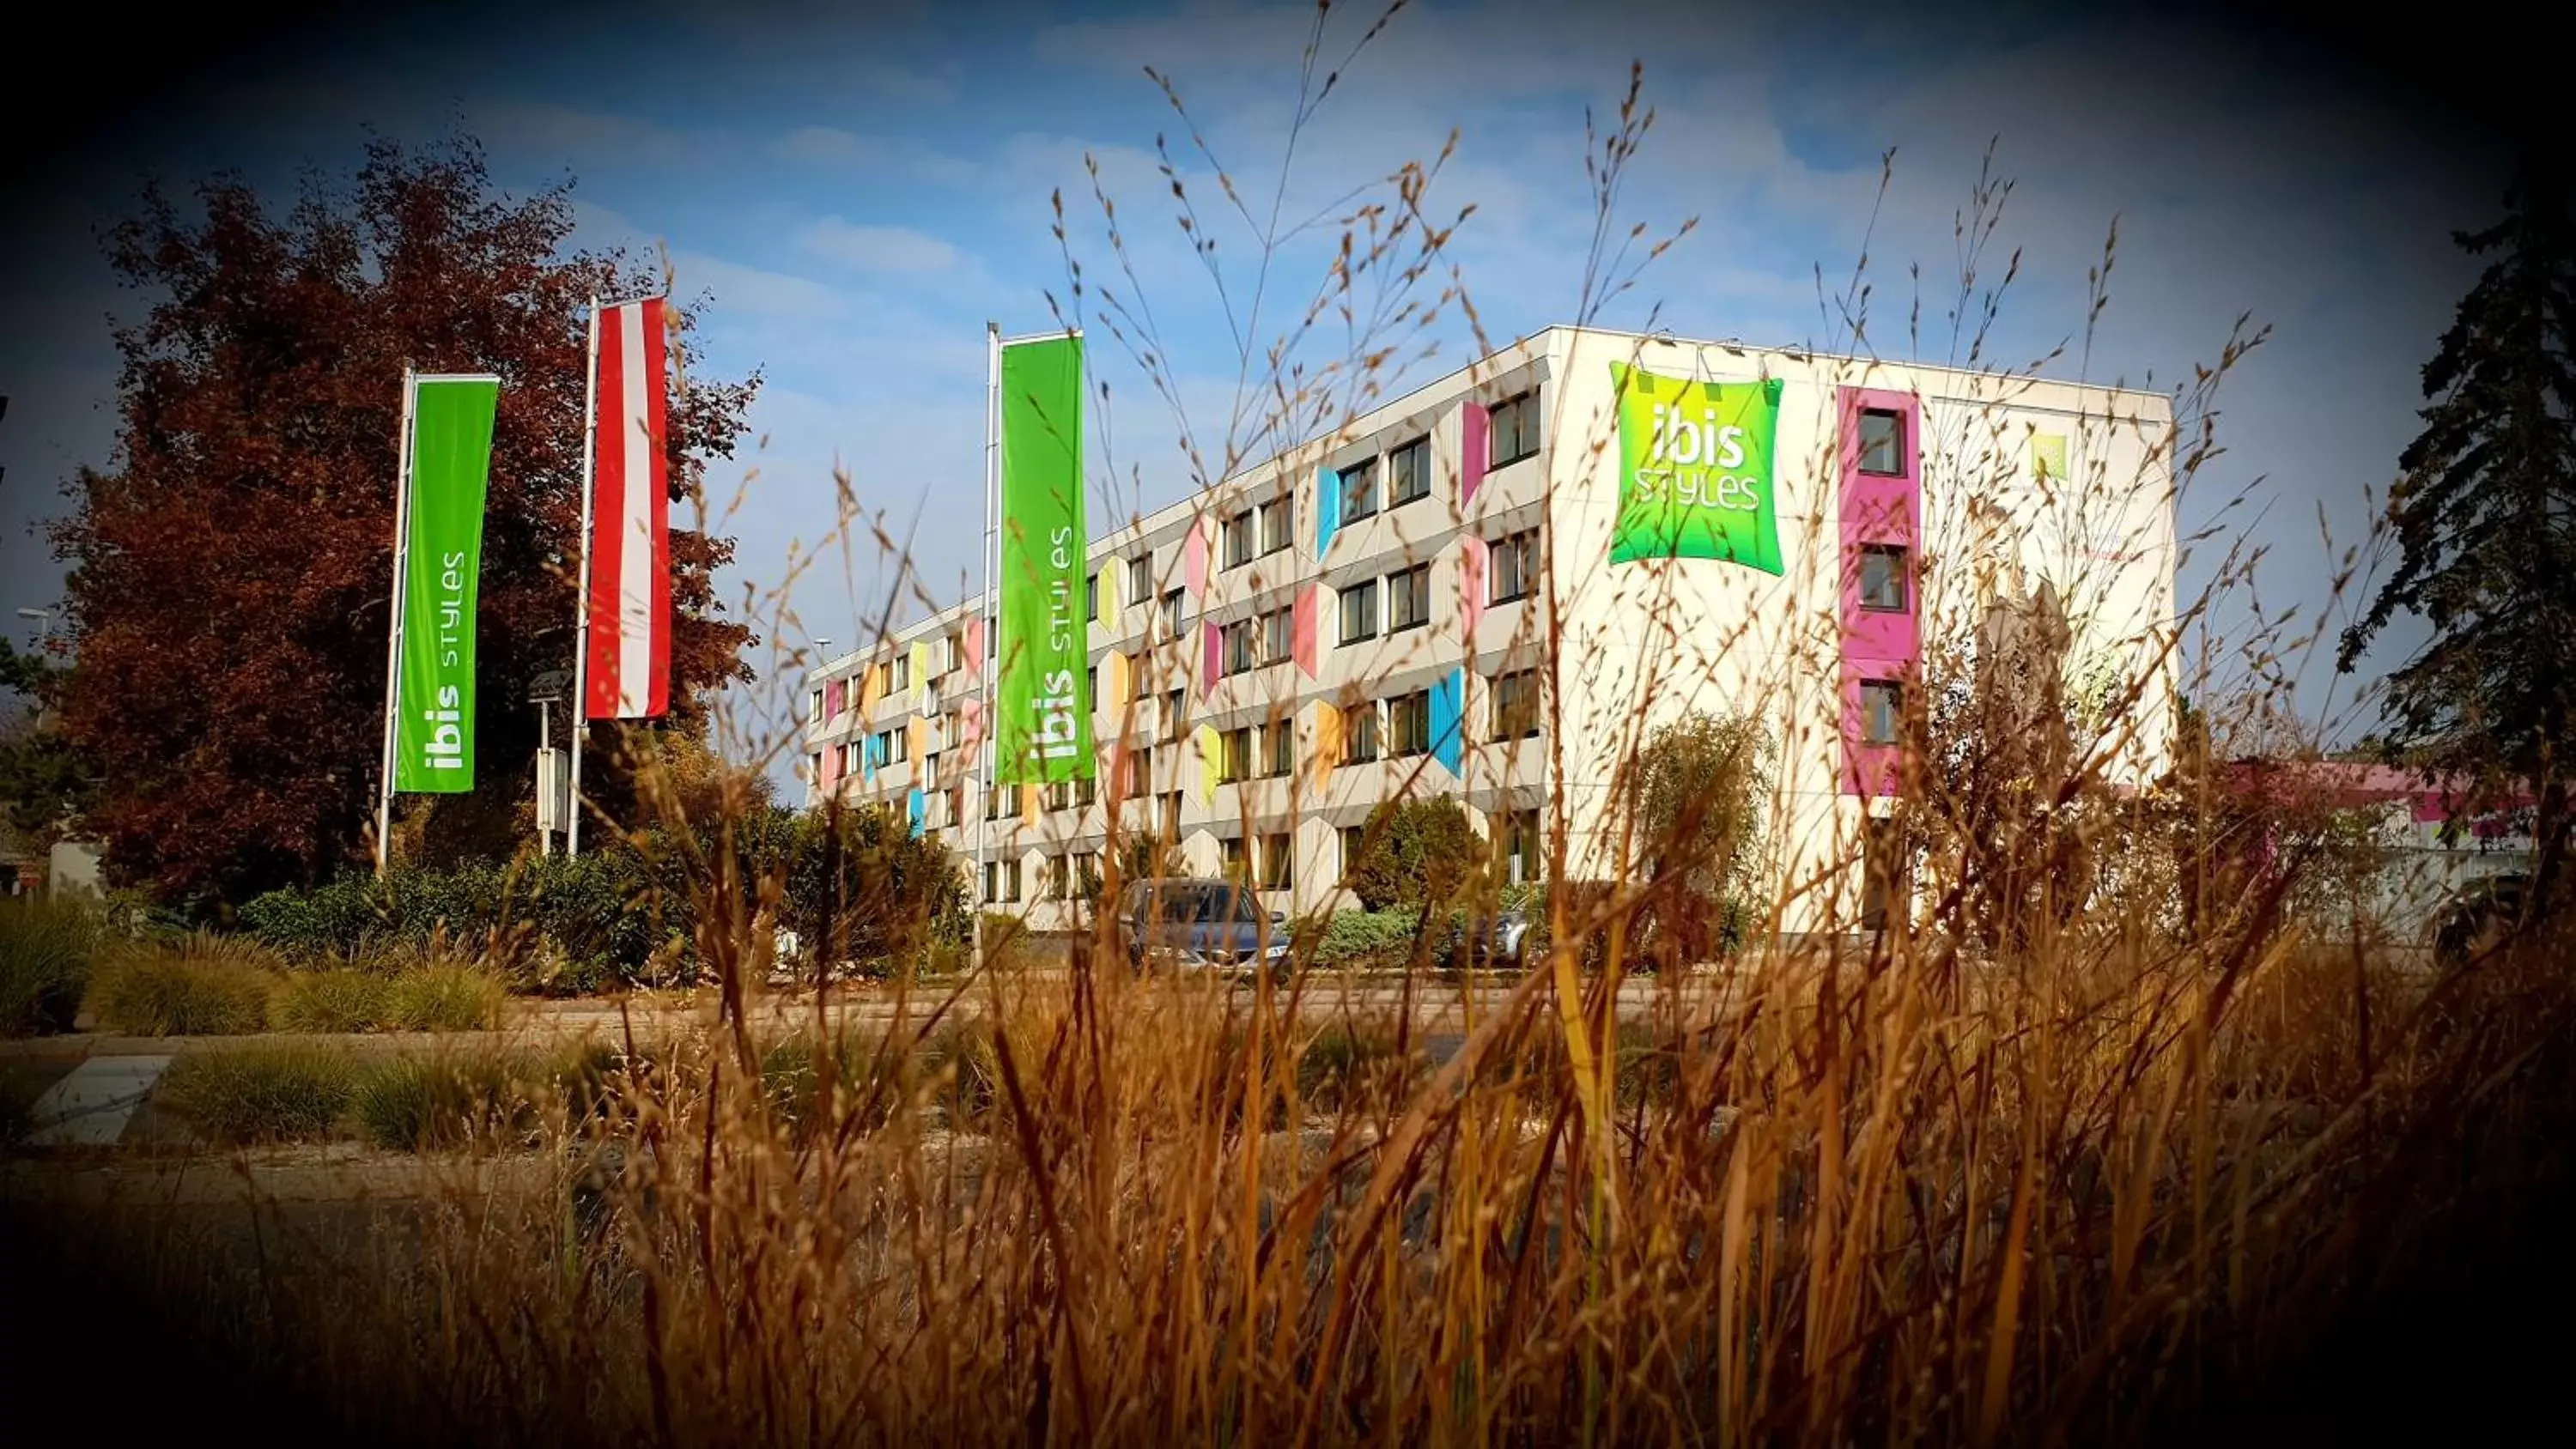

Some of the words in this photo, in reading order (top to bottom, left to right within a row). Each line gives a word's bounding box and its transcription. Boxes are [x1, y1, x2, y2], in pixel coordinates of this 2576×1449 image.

[1652, 403, 1744, 469] ibis
[425, 685, 462, 767] ibis
[1030, 670, 1077, 759] ibis
